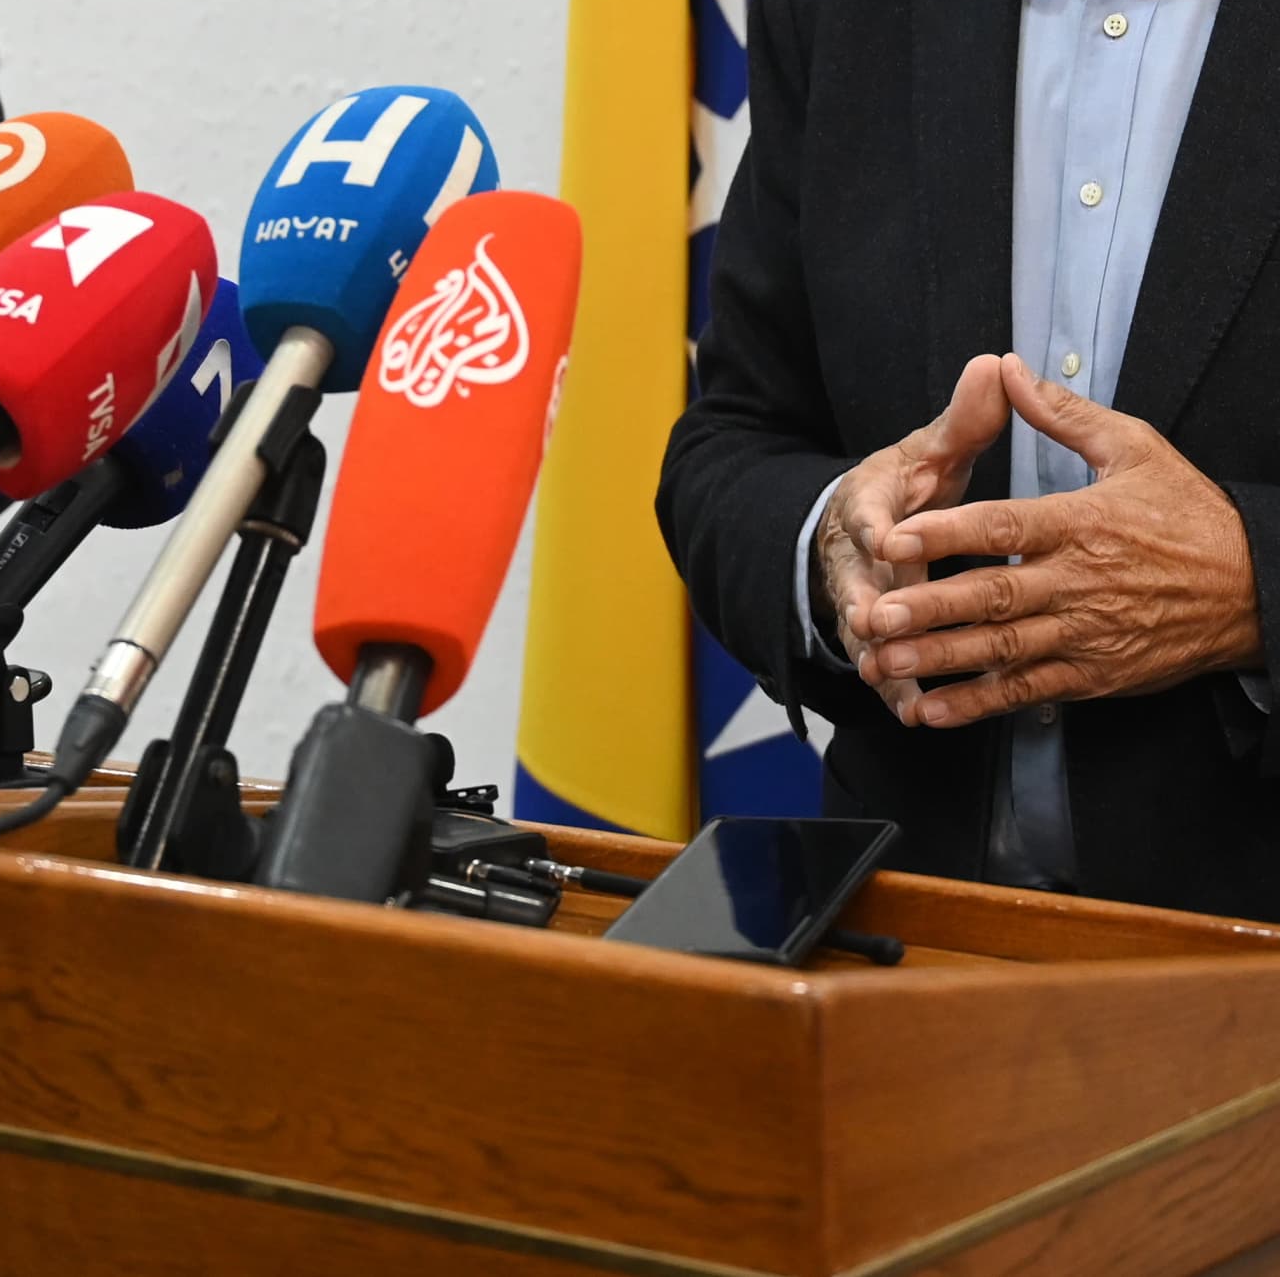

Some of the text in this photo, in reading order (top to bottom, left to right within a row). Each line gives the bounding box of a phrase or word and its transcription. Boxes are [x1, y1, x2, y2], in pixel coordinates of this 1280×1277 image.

[275, 94, 430, 188] H
[254, 215, 358, 243] HAYAT
[83, 372, 115, 461] TVSA
